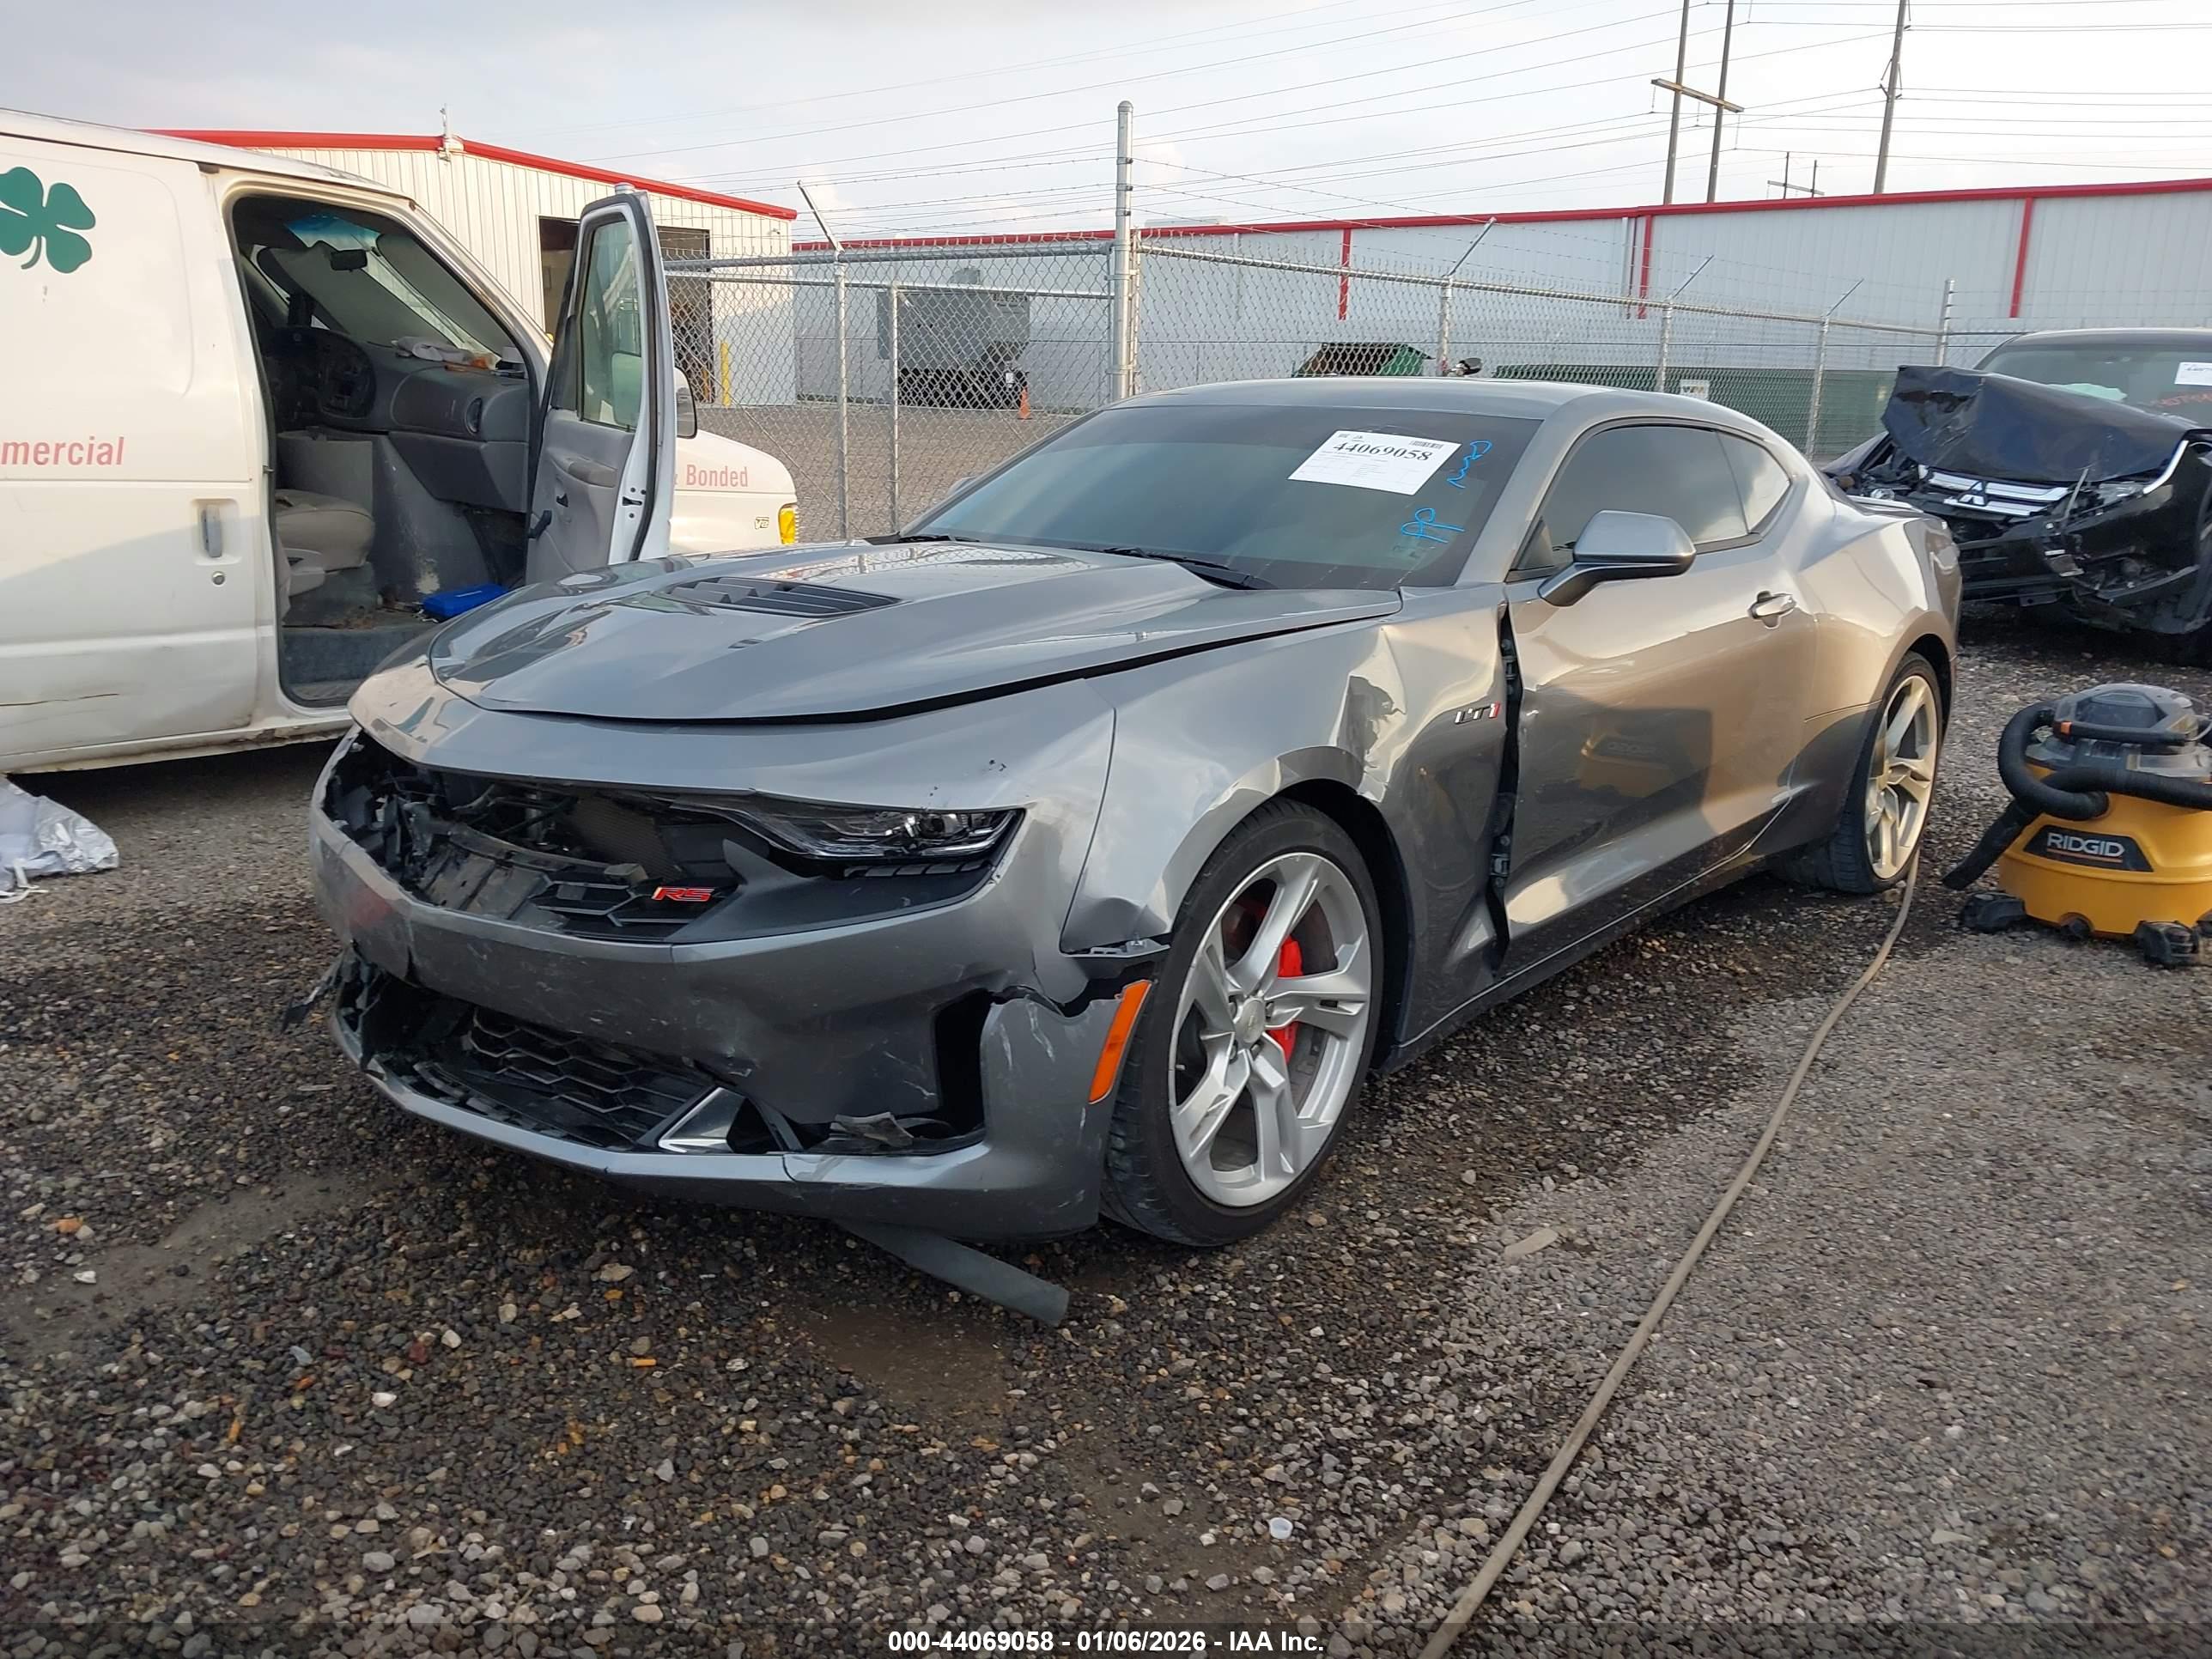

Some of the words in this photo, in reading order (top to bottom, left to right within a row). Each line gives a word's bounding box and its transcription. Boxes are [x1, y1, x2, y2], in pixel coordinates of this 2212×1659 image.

[1333, 441, 1433, 461] 44069058
[686, 464, 749, 487] Bonded
[2046, 832, 2125, 858] RIDGID
[651, 886, 715, 902] RS
